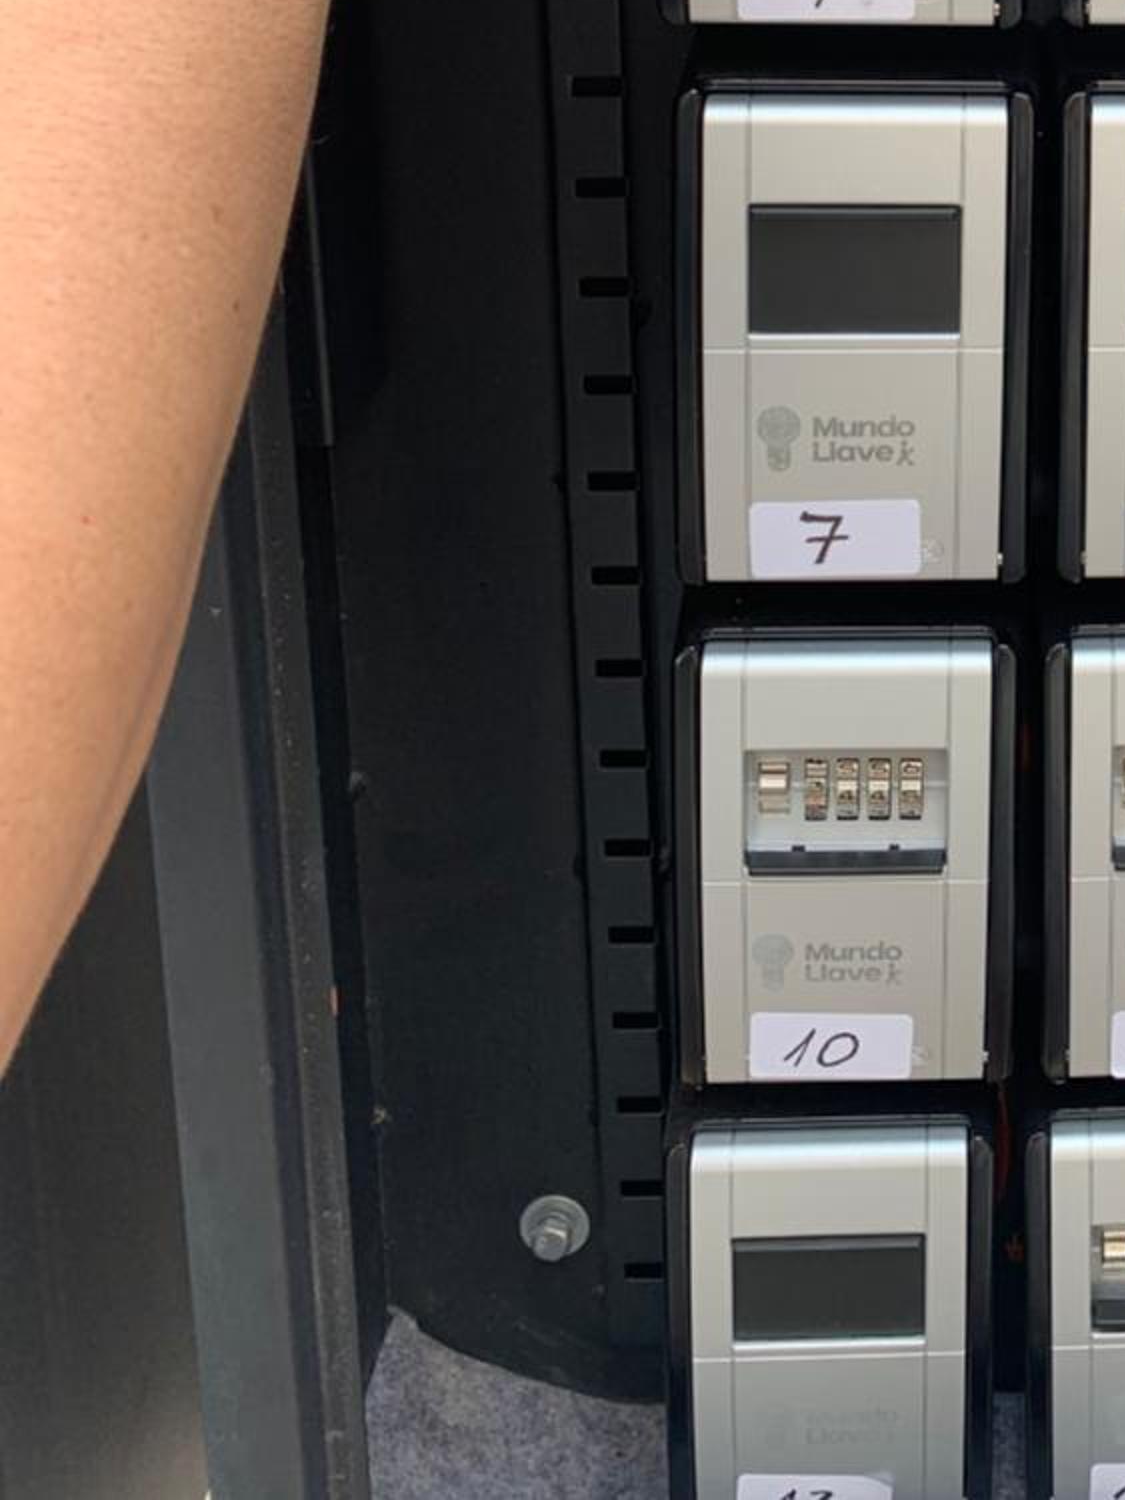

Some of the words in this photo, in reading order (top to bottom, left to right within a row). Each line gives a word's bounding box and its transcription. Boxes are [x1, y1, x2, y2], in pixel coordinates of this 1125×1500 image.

[812, 415, 916, 438] Mundo
[812, 441, 894, 463] Llave
[799, 510, 850, 565] 7
[805, 941, 903, 962] Mundo
[805, 963, 882, 983] Llave
[783, 1027, 860, 1068] 10
